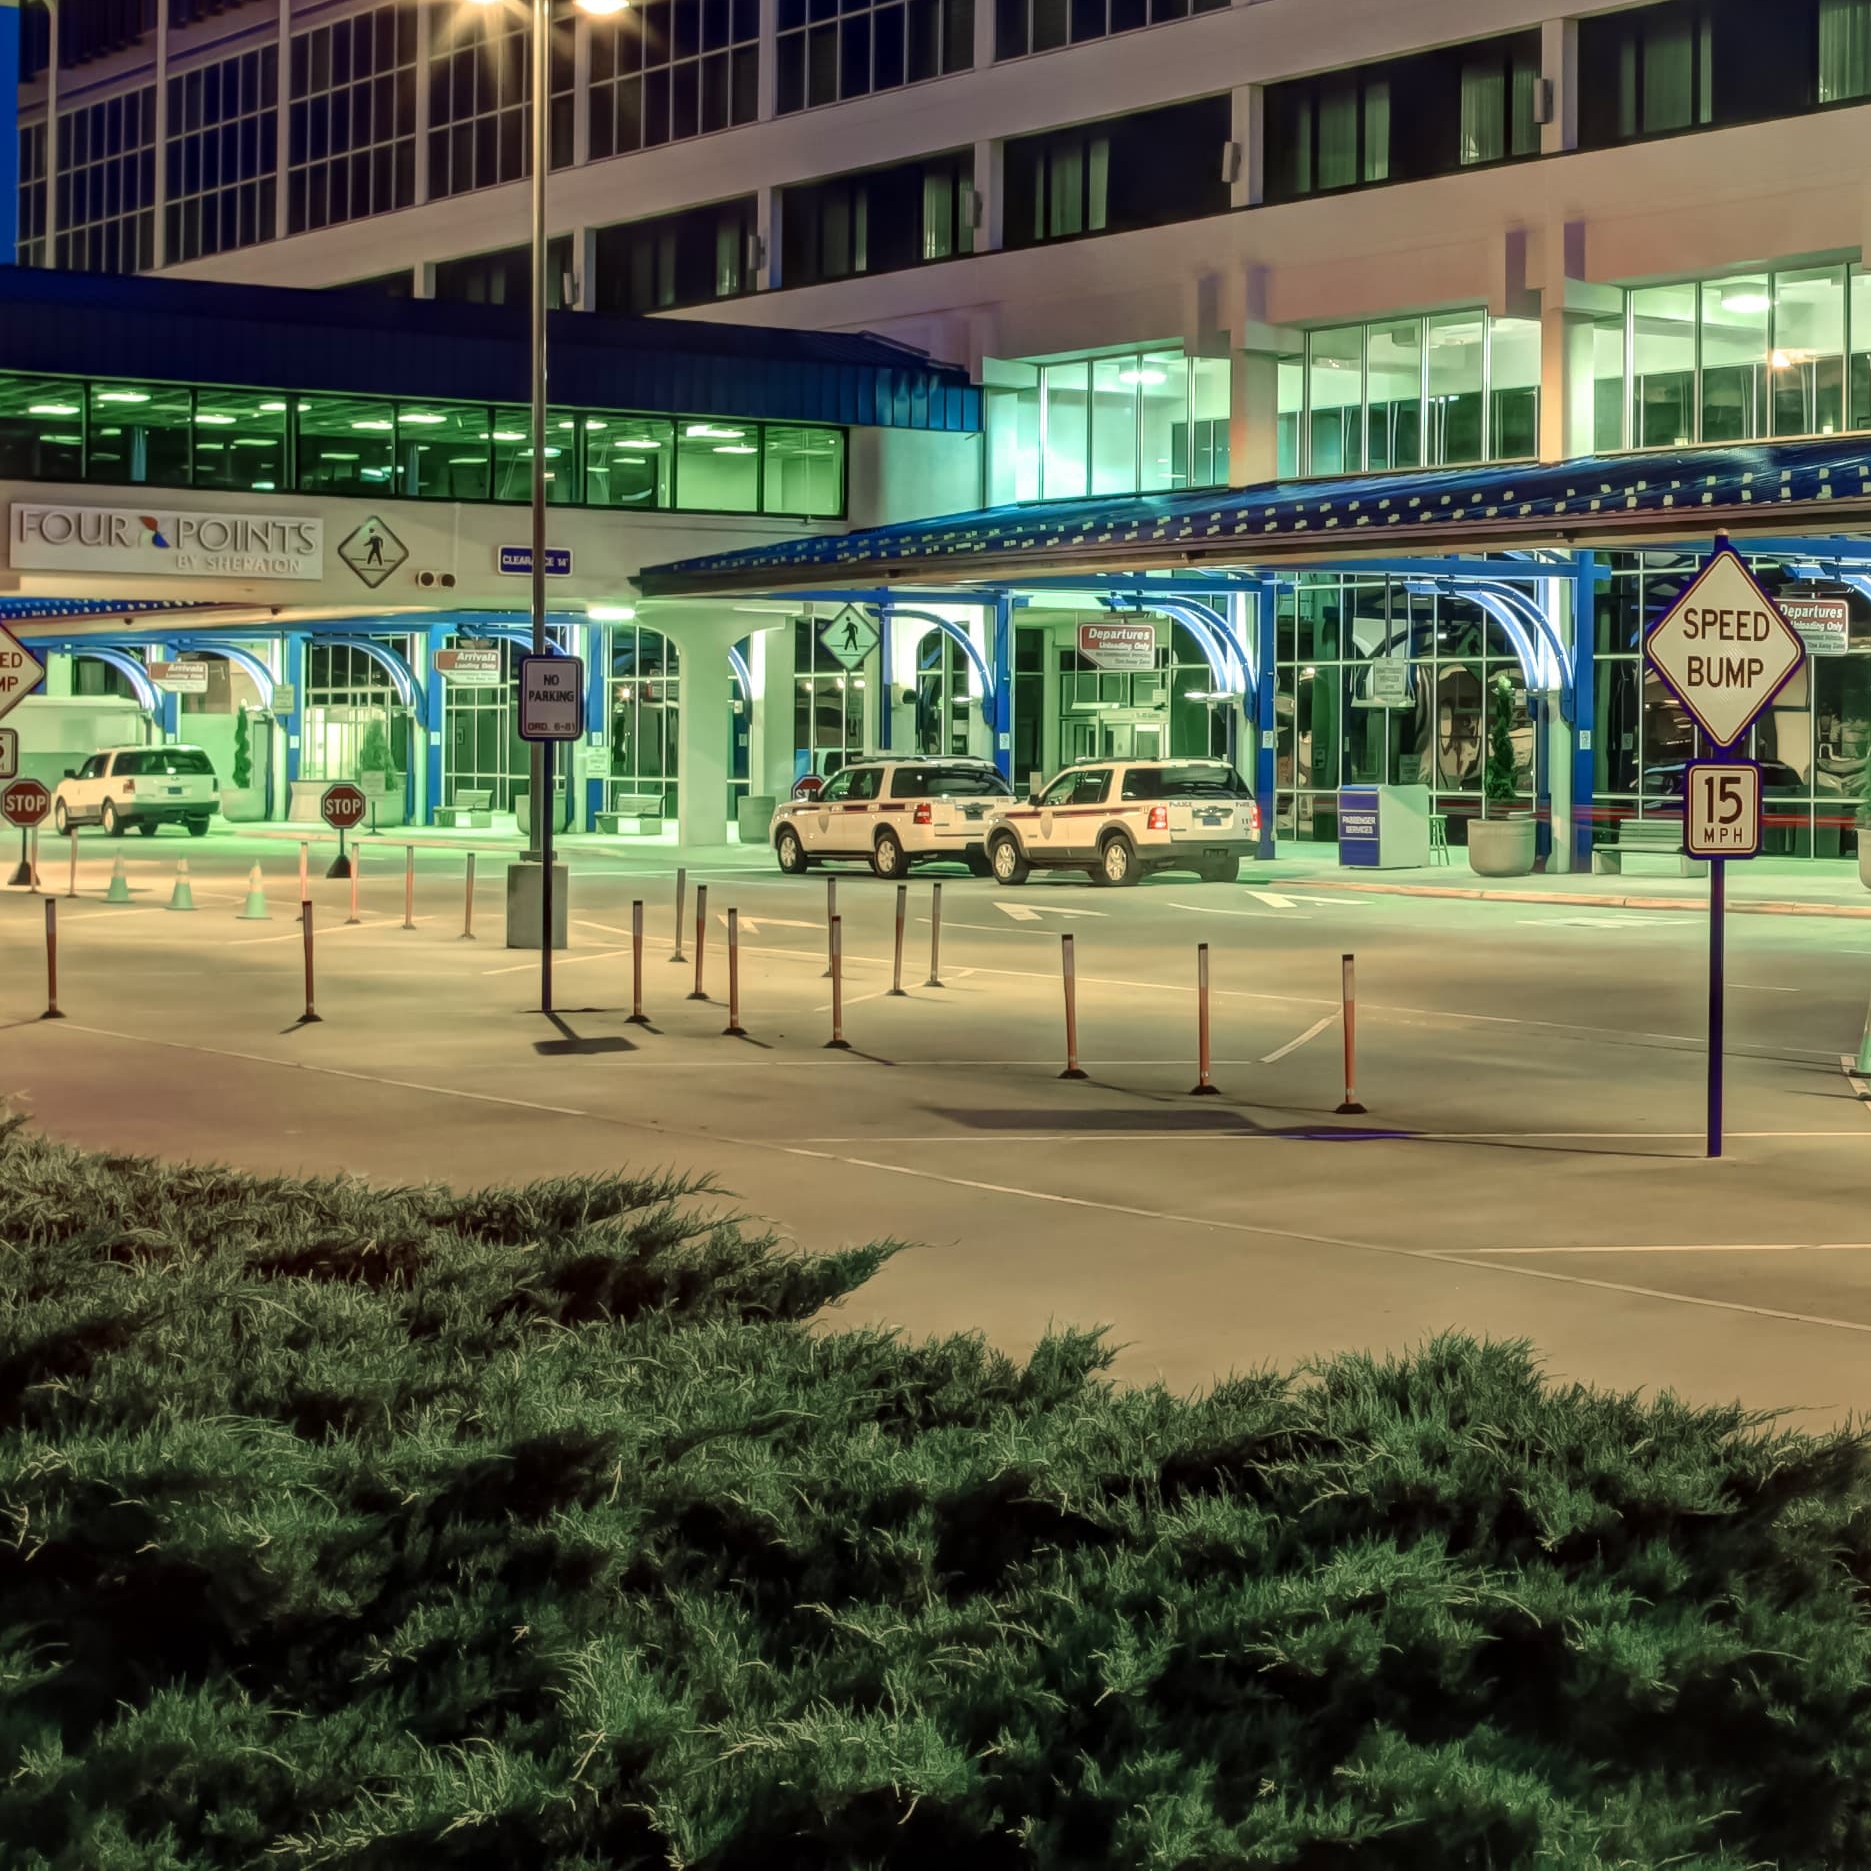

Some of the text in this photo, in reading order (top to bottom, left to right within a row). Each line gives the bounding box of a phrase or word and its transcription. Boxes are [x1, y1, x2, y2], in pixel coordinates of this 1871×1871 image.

[20, 510, 317, 555] FOUR POINTS
[176, 554, 302, 574] BY SHERATON
[1682, 607, 1770, 642] SPEED
[1088, 627, 1150, 640] Departures
[456, 651, 497, 661] Arrivals
[543, 674, 560, 686] NO
[1687, 655, 1764, 689] BUMP
[528, 690, 575, 702] PARKING
[5, 794, 47, 812] STOP
[325, 798, 362, 815] STOP
[1704, 776, 1743, 824] 15
[1704, 827, 1743, 843] MPH
